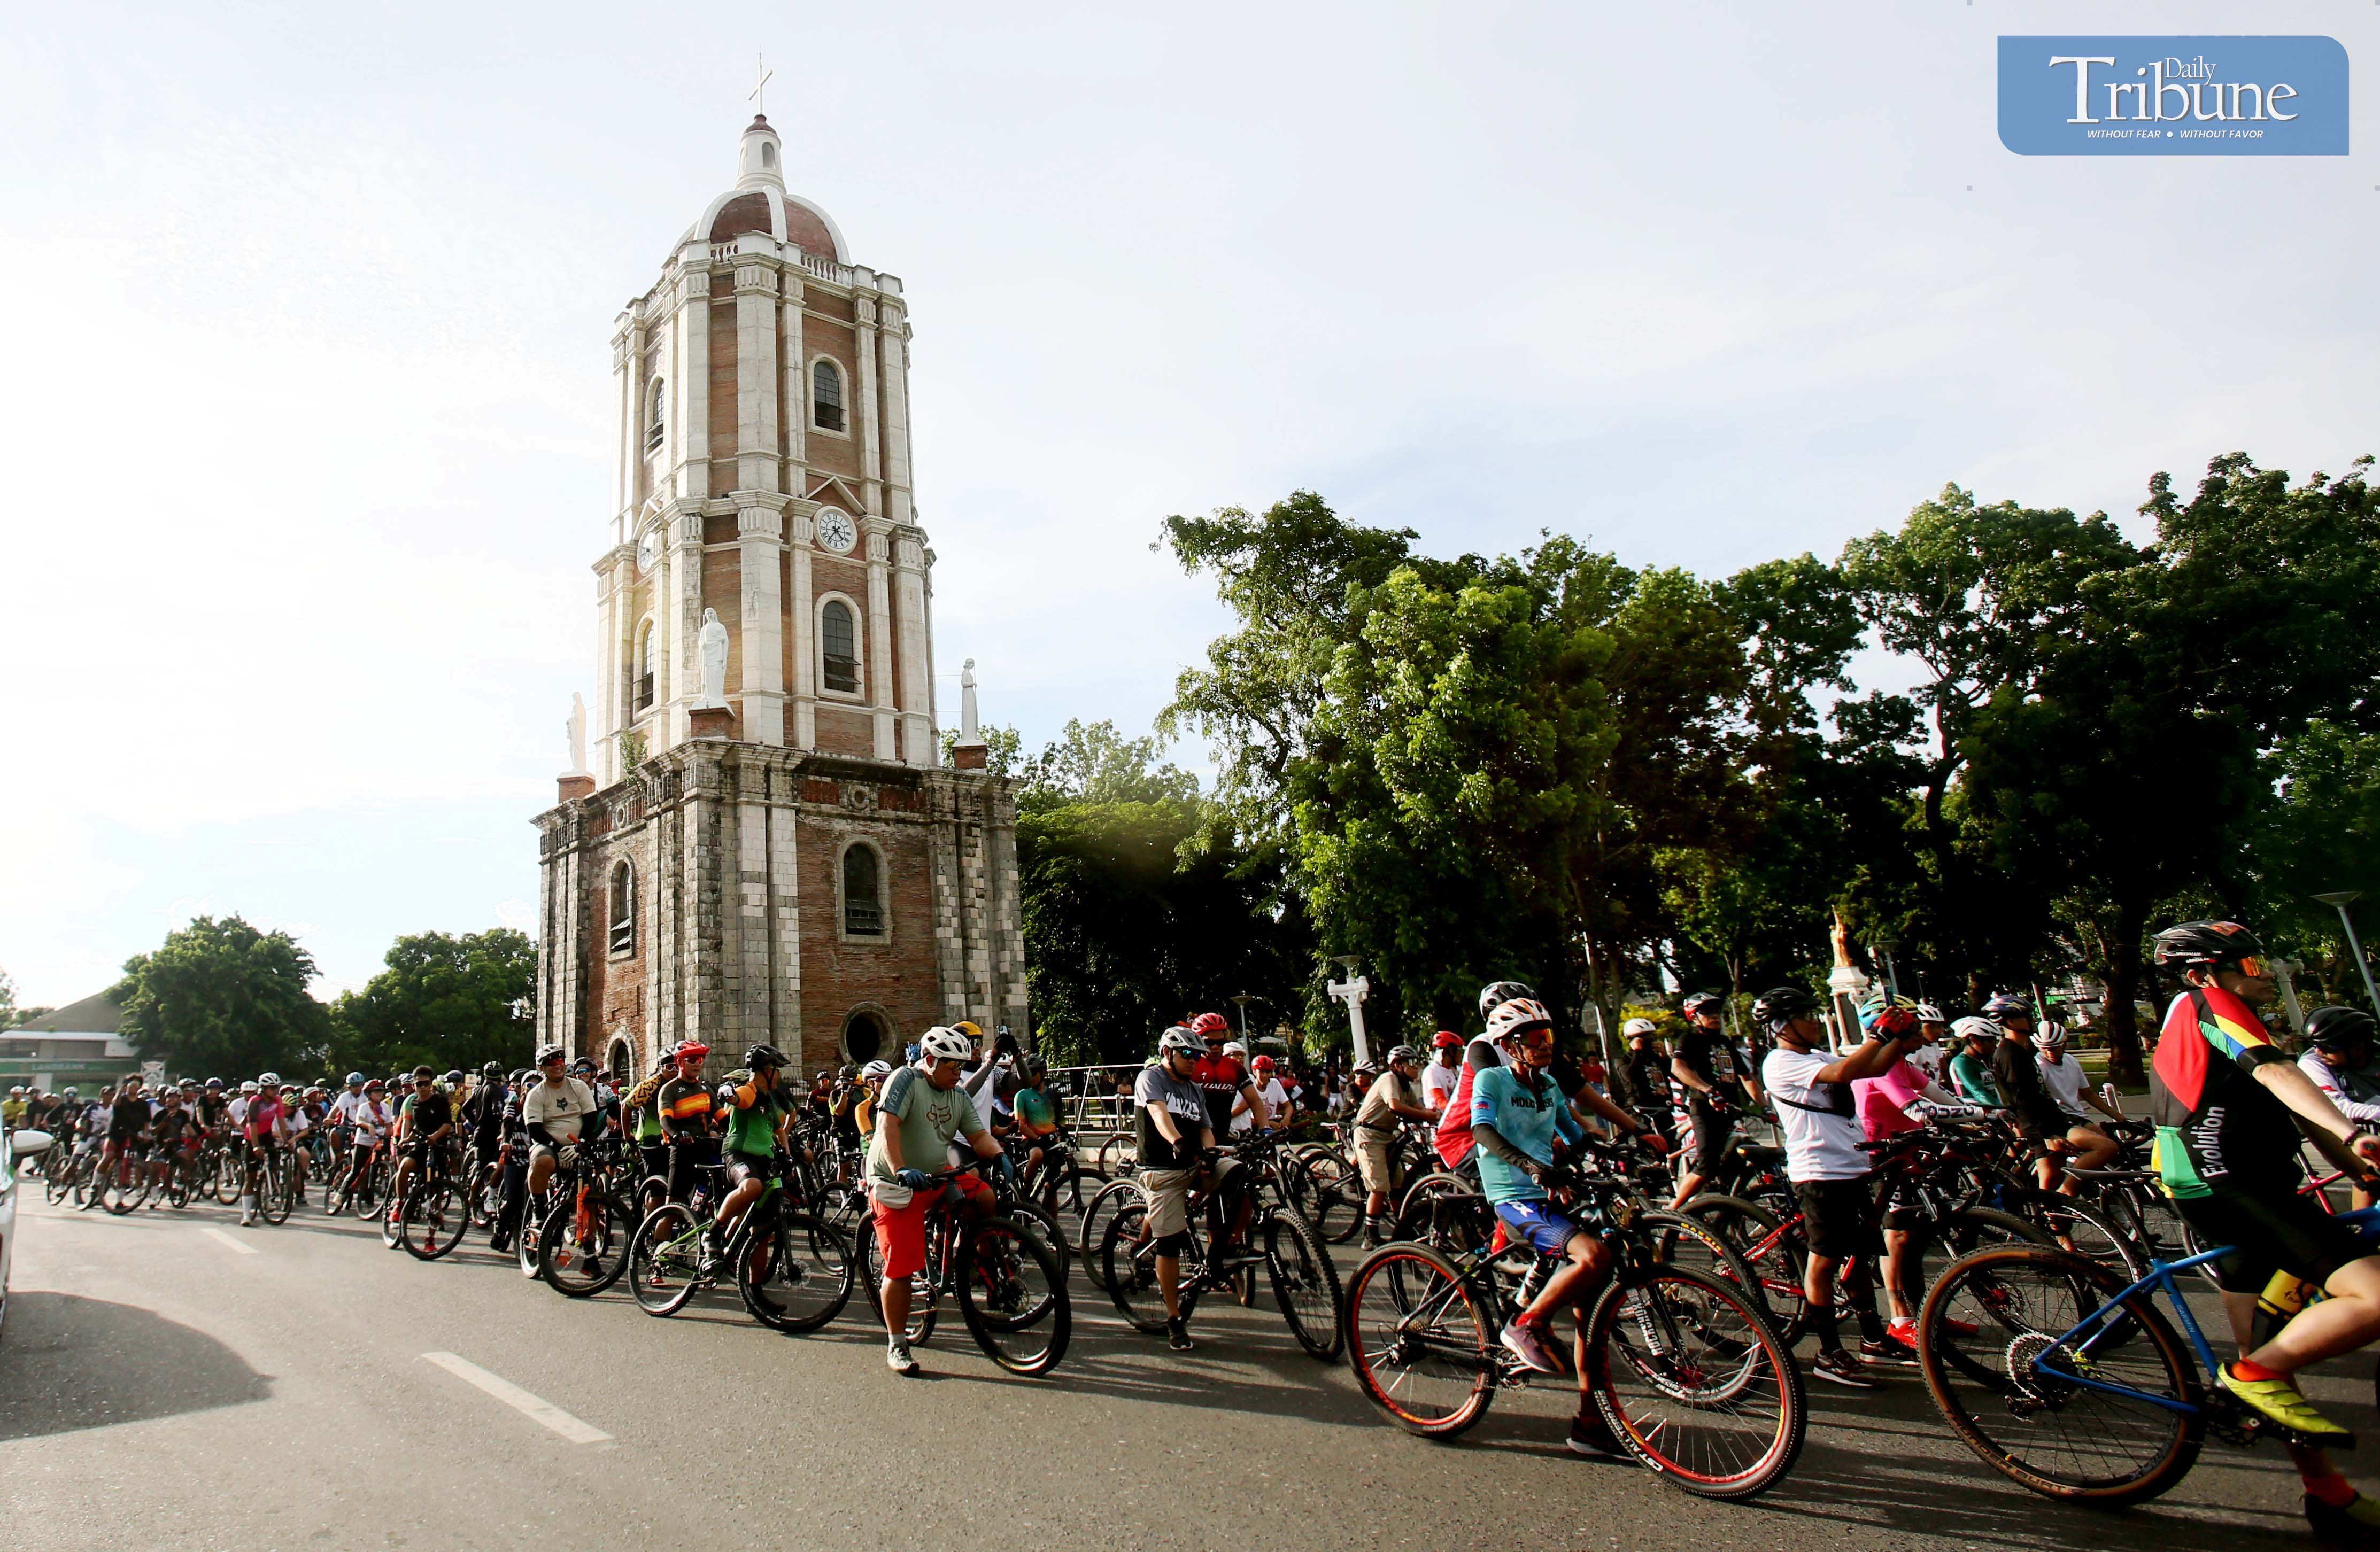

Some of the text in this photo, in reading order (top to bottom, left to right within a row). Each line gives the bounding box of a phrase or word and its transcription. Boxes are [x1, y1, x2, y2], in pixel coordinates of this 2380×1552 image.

[890, 1088, 900, 1106] FOX
[2190, 1106, 2229, 1177] Evolution
[1681, 1222, 1722, 1251] MAXXIS
[1633, 1302, 1664, 1356] ROCKSHOX
[2176, 1305, 2195, 1332] GARMIN
[1598, 1390, 1664, 1472] CST ALL TERRAINS
